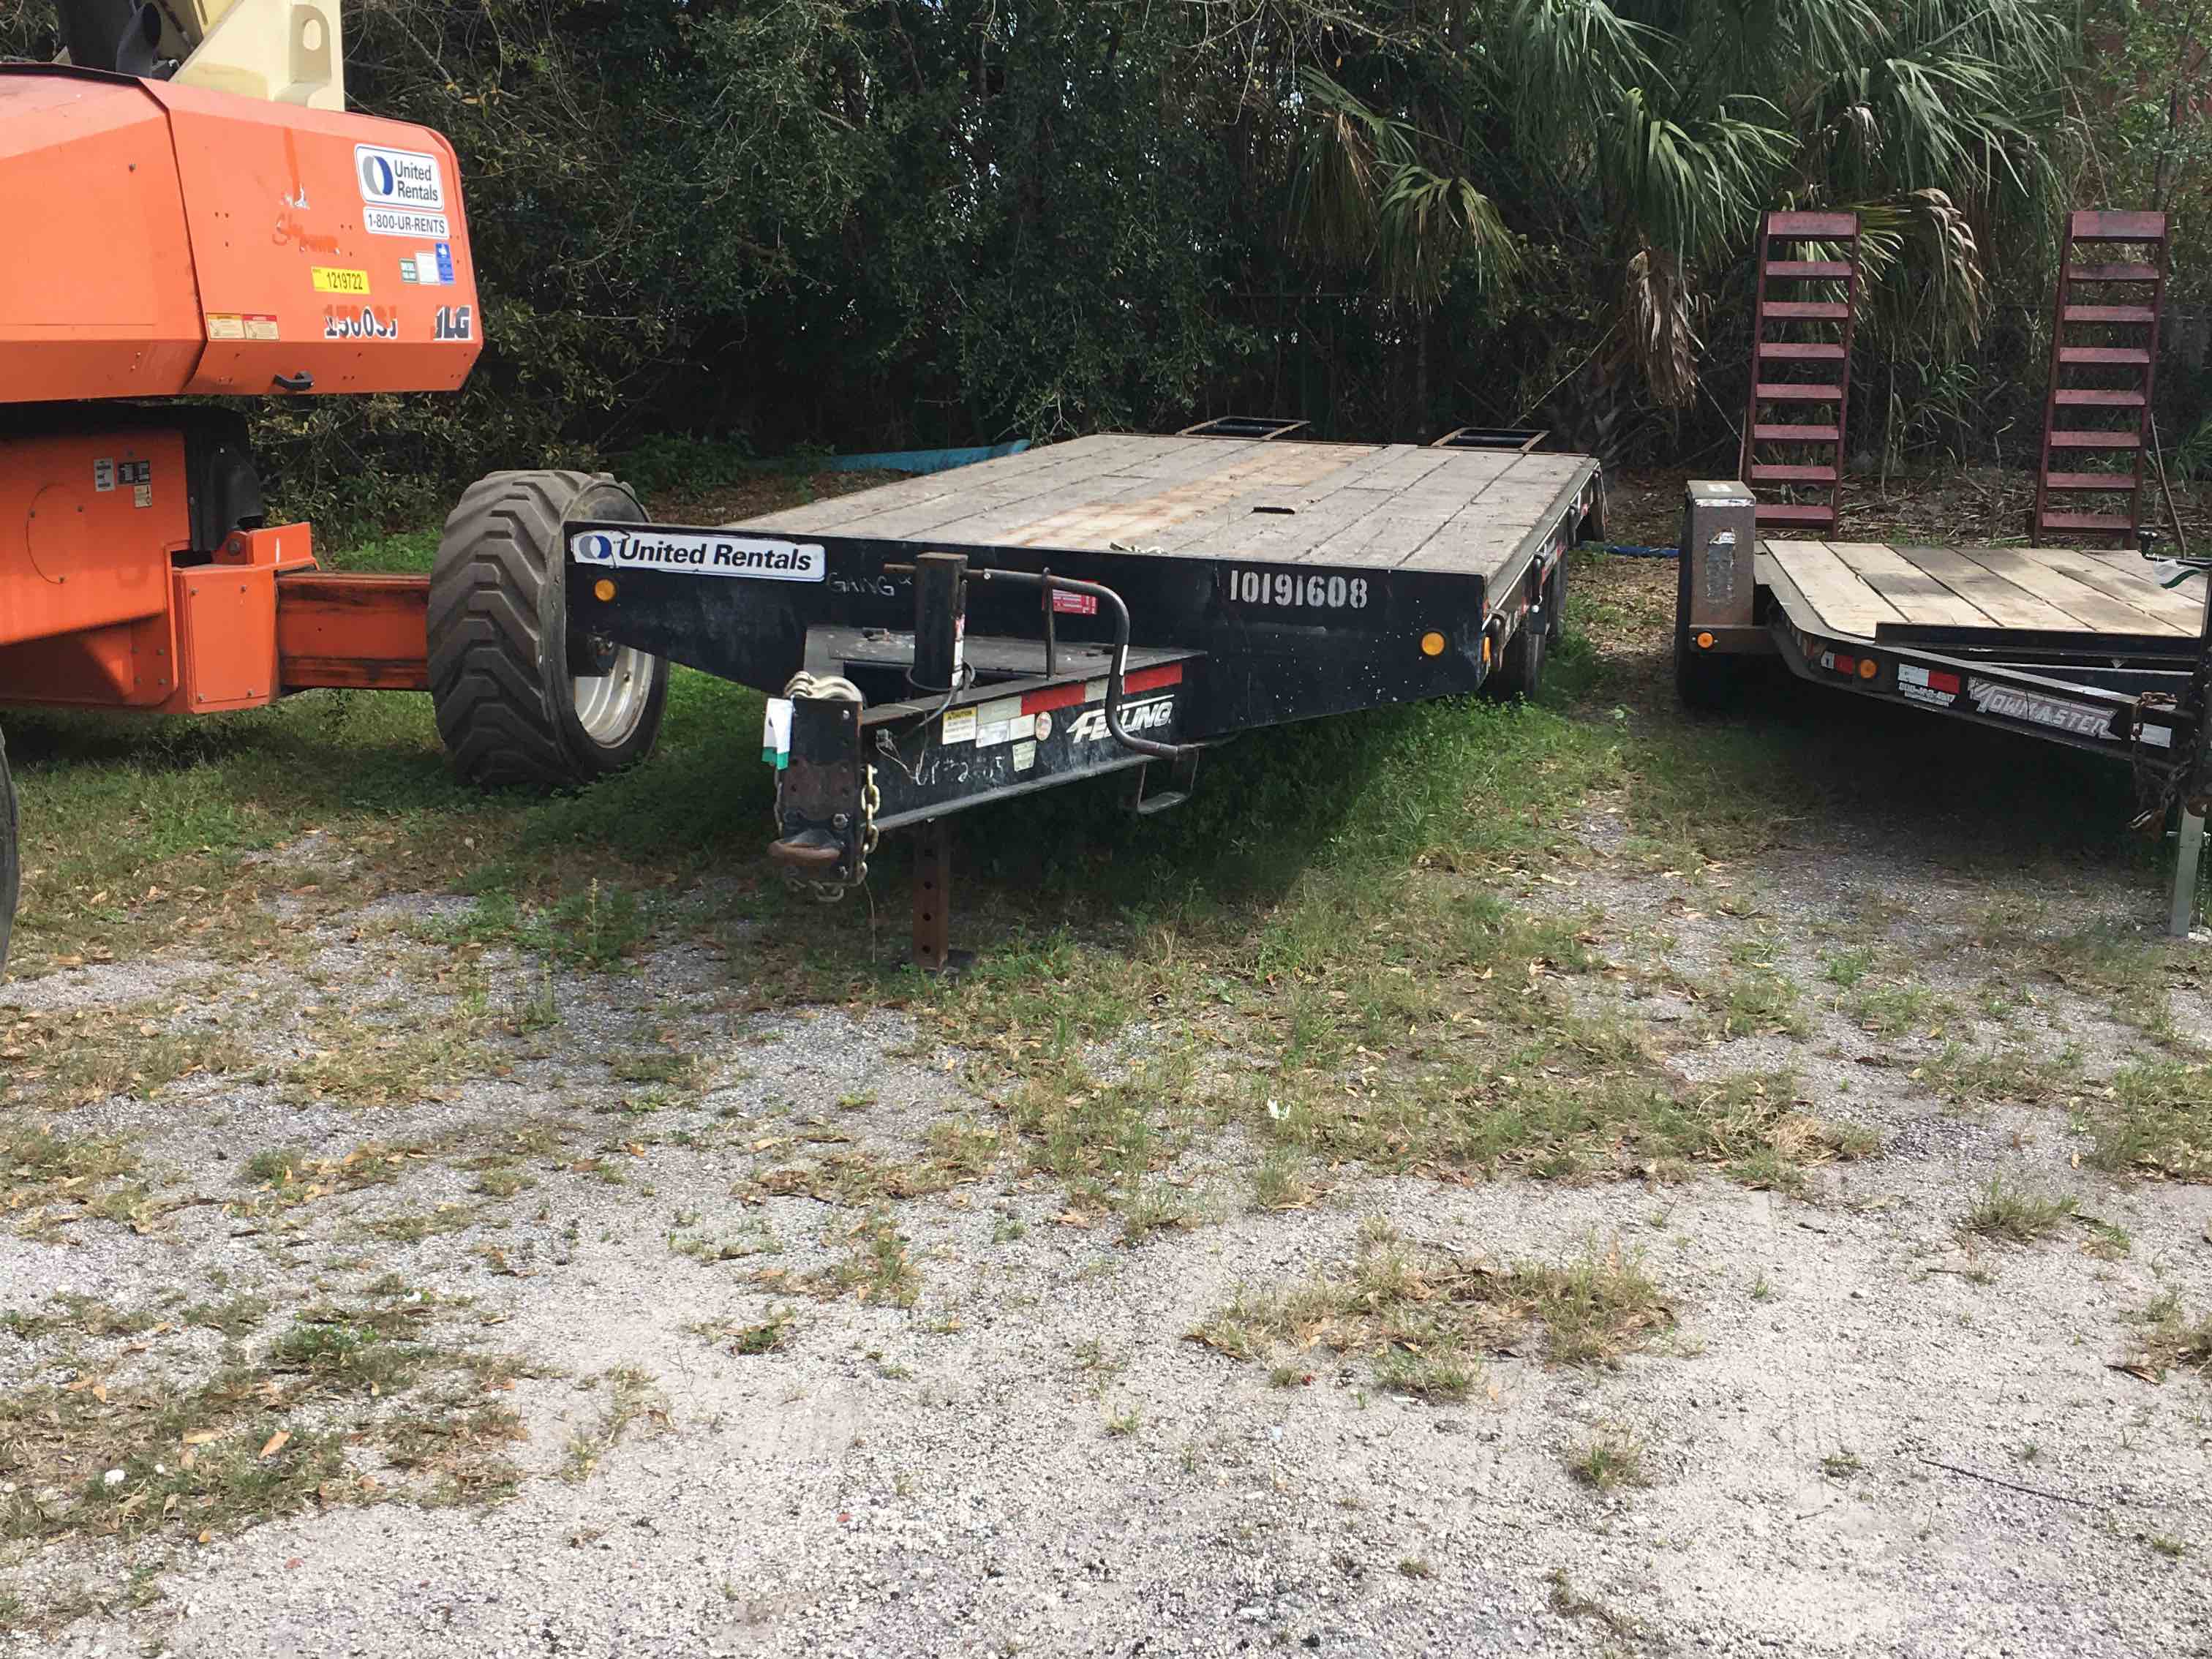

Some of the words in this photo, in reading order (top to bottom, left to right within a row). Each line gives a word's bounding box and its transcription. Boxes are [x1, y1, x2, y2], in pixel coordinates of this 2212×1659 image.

[394, 159, 432, 181] United
[397, 181, 438, 201] Rentals
[368, 214, 445, 234] 1-800-UR-RENTS
[327, 271, 364, 290] 1219722
[620, 539, 705, 565] United
[714, 543, 812, 571] Rentals
[1230, 570, 1368, 609] 10191608
[1066, 695, 1174, 743] FELING
[1969, 680, 2121, 740] TOWMASTER
